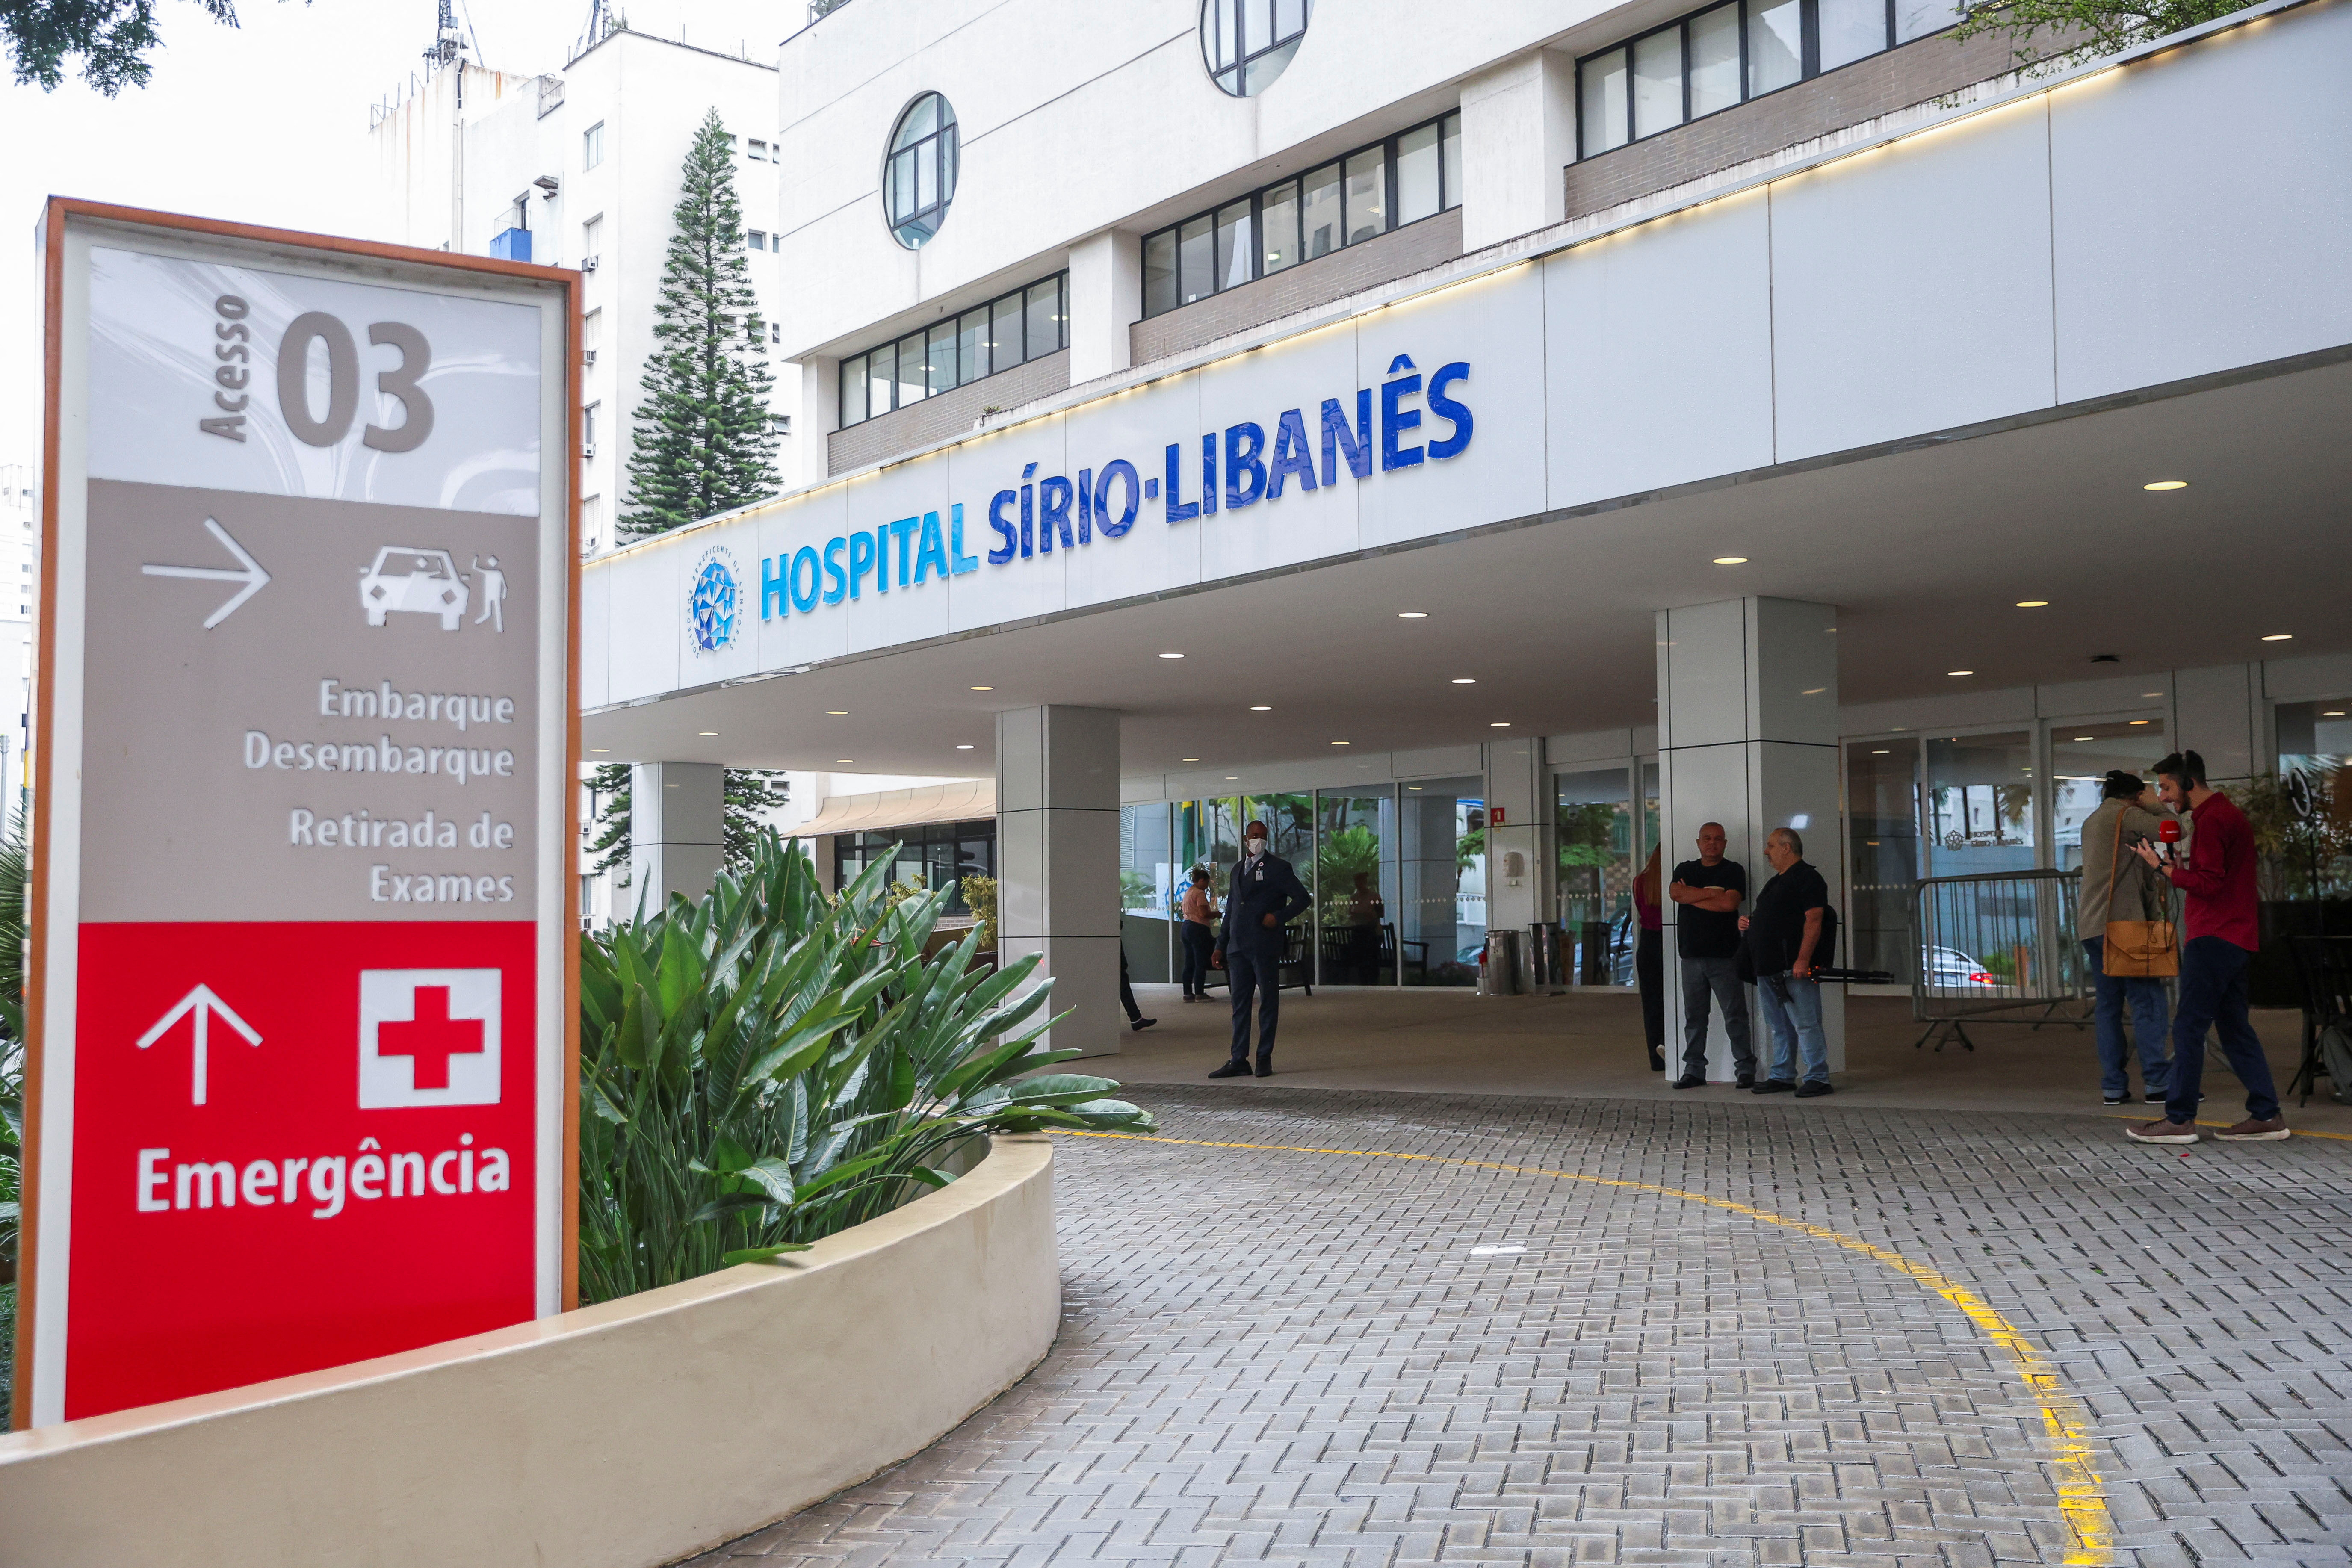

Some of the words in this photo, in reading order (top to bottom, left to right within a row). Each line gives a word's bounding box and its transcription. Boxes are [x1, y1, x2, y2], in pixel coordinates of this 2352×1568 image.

[200, 295, 250, 443] Acesso
[276, 311, 434, 454] 03
[692, 545, 732, 582] BENEFICENTE
[733, 560, 740, 574] DE
[761, 502, 979, 621] HOSPITAL
[687, 589, 700, 659] SOCIEDADE
[730, 581, 744, 650] SENHORAS
[321, 680, 515, 731] Embarque
[246, 731, 515, 785] Desembarque
[291, 809, 457, 849] Retirada
[470, 812, 515, 849] de
[372, 865, 514, 902] Exames
[137, 1133, 510, 1218] Emergência
